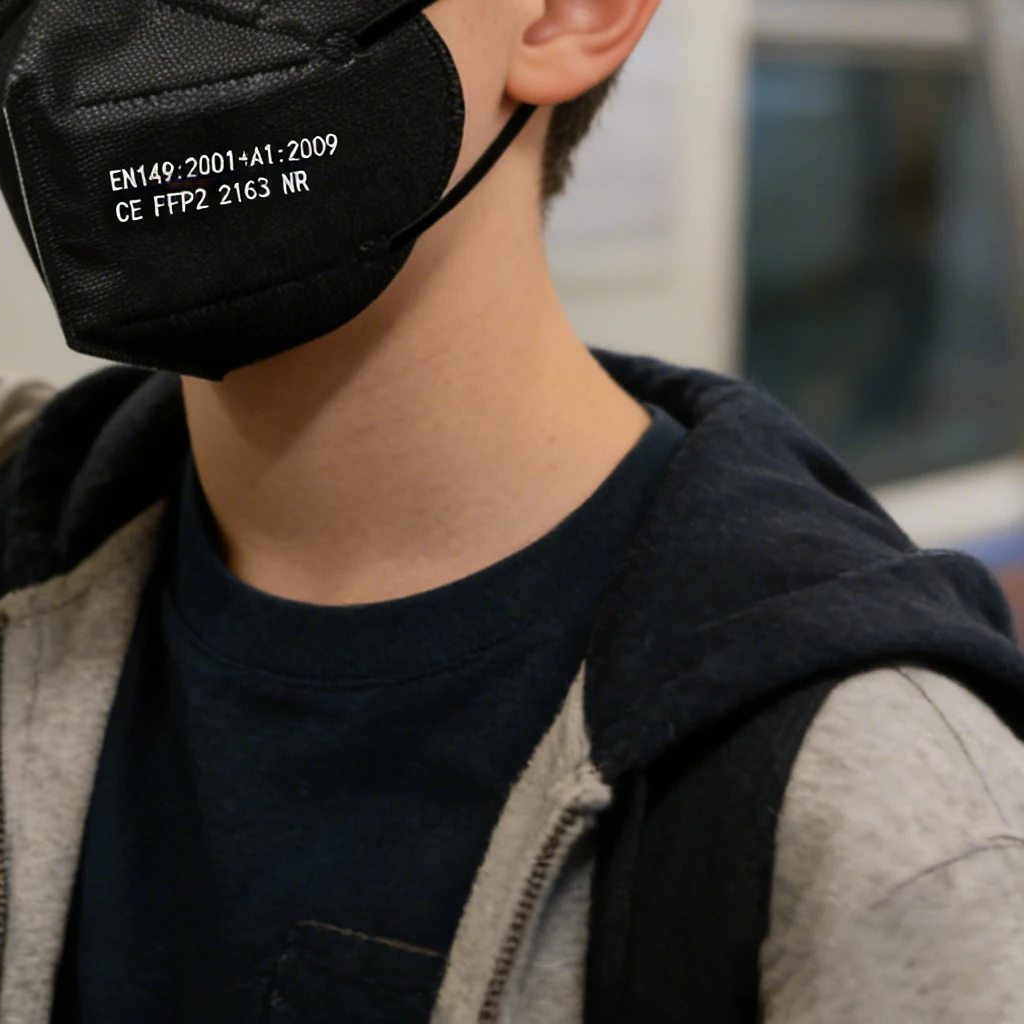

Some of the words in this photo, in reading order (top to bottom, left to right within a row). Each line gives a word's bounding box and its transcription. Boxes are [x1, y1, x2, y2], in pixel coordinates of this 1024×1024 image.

[109, 133, 338, 191] EN149:2001+A1:2009
[115, 199, 143, 222] CE
[154, 188, 209, 217] FFP2
[219, 177, 271, 205] 2163
[282, 170, 310, 195] NR
